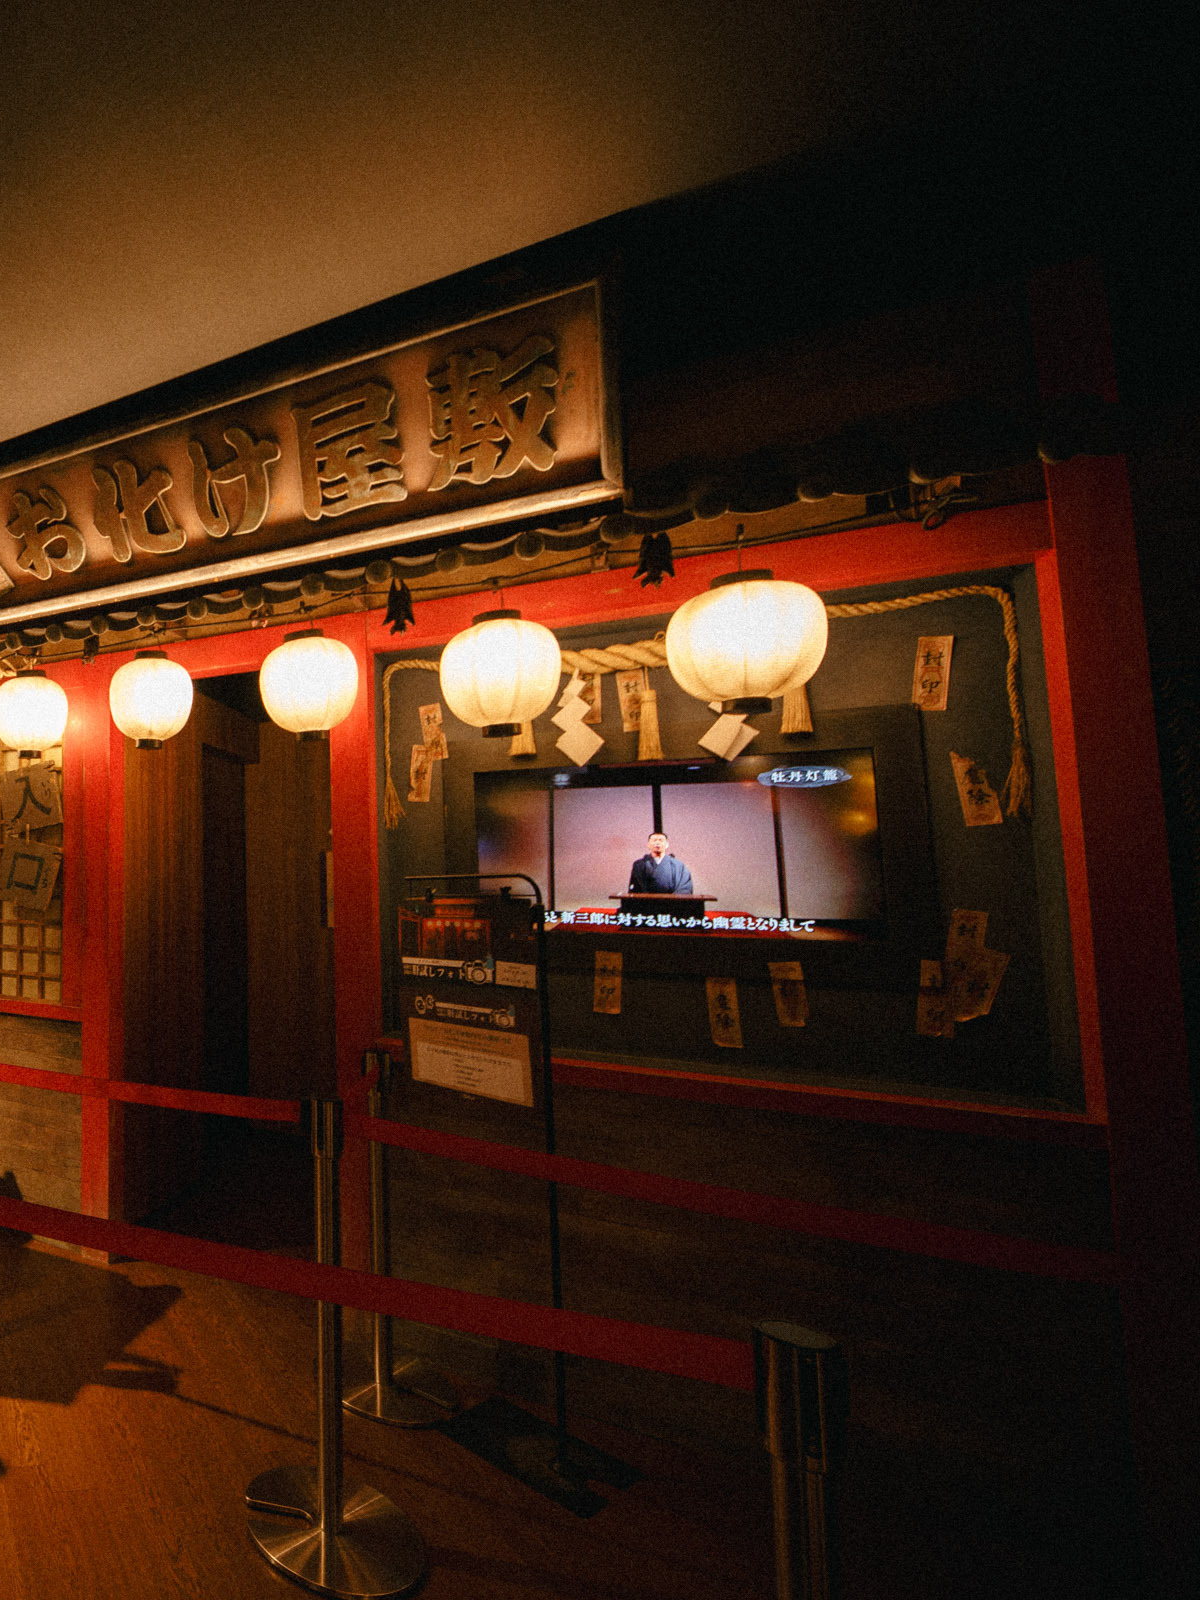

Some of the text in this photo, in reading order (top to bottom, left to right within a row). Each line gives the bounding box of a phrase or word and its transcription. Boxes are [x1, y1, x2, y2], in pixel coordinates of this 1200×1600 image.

[4, 334, 561, 581] お化け屋敷
